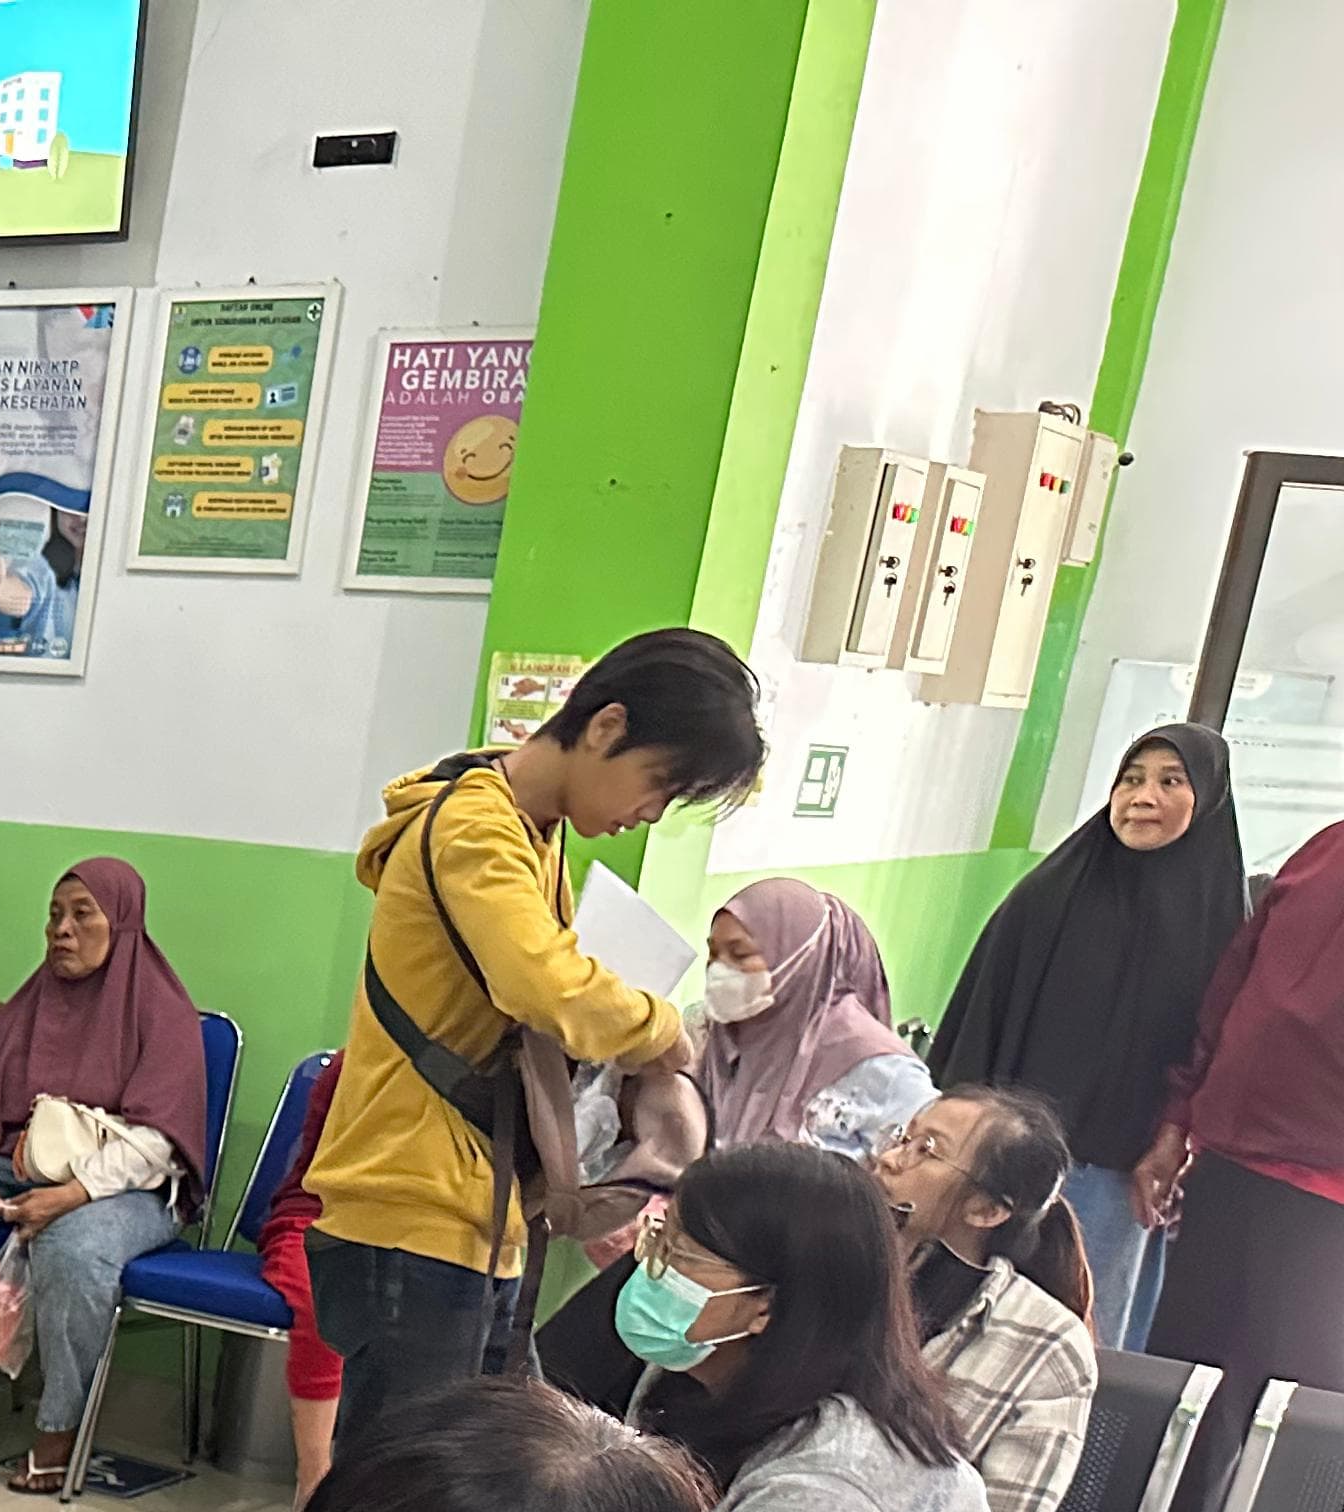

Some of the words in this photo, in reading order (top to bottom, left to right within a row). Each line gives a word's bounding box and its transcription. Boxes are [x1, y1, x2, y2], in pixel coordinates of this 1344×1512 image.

[392, 347, 453, 369] HATI
[13, 379, 82, 392] LAYANAN
[401, 369, 527, 391] GEMBIRA
[0, 396, 87, 409] KESEHATAN
[385, 390, 470, 405] ADALAH
[482, 390, 525, 405] OBA
